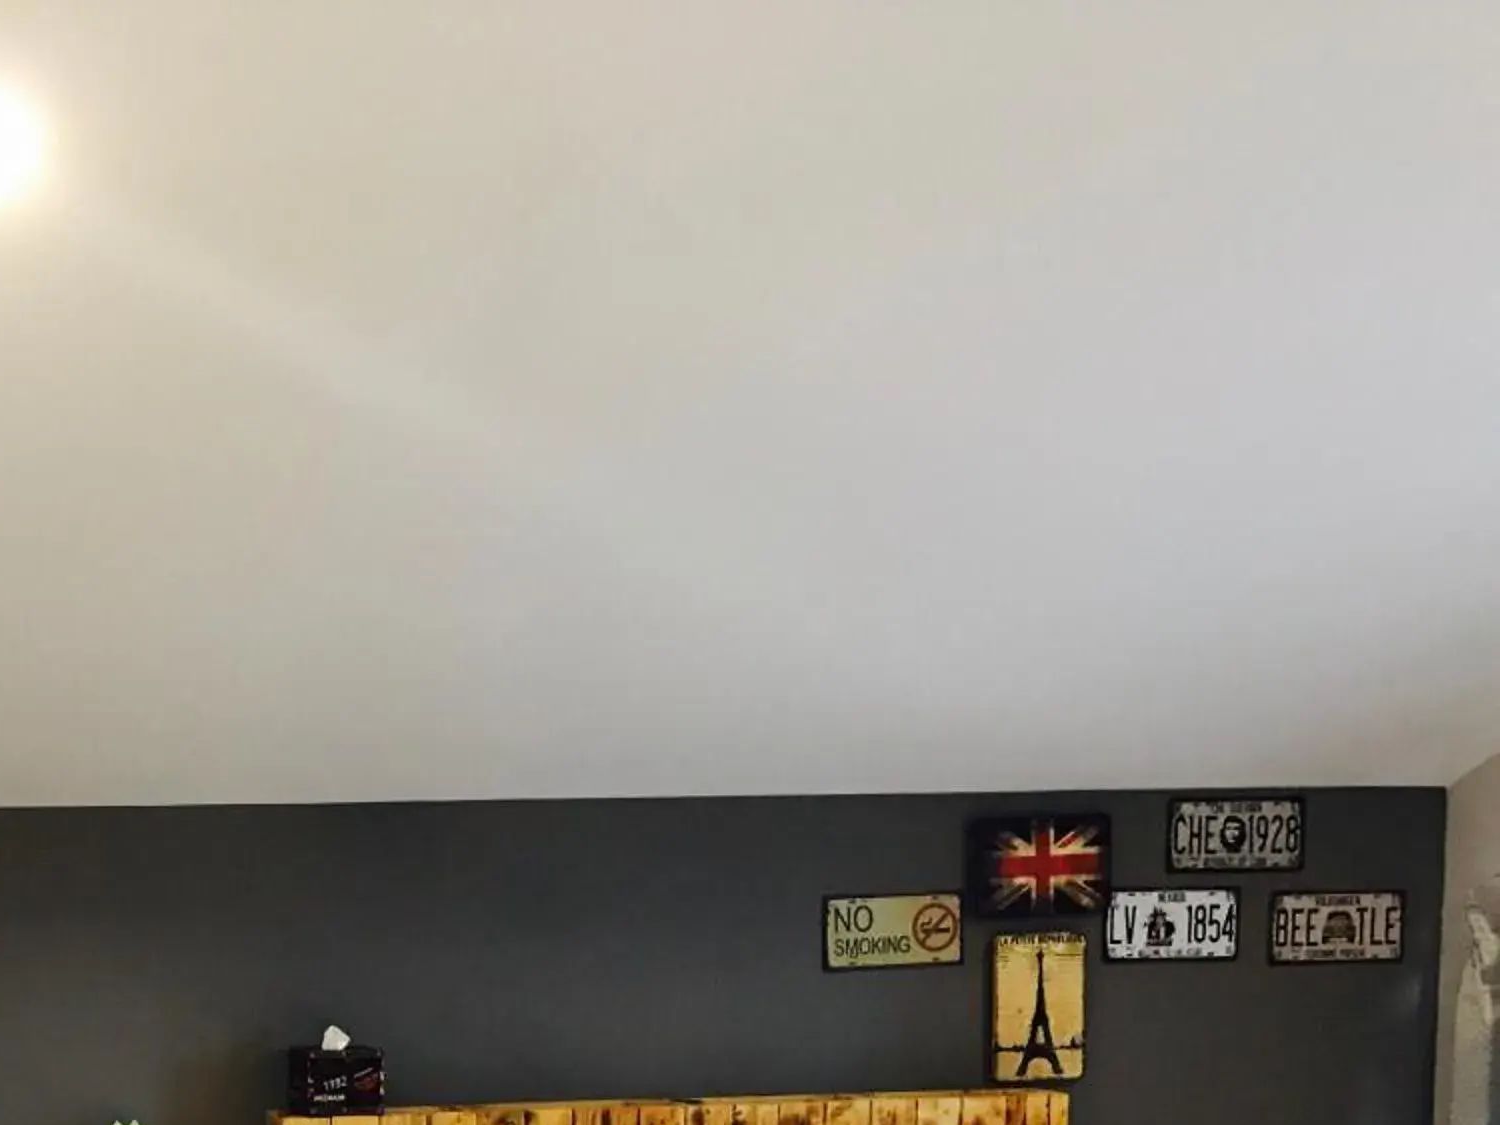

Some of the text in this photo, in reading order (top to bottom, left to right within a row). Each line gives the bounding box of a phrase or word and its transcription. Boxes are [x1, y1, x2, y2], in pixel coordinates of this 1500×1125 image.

[1173, 814, 1299, 855] CHE 1928
[833, 905, 874, 933] NO
[1109, 903, 1235, 944] LV 1854
[833, 935, 911, 958] SMOKING
